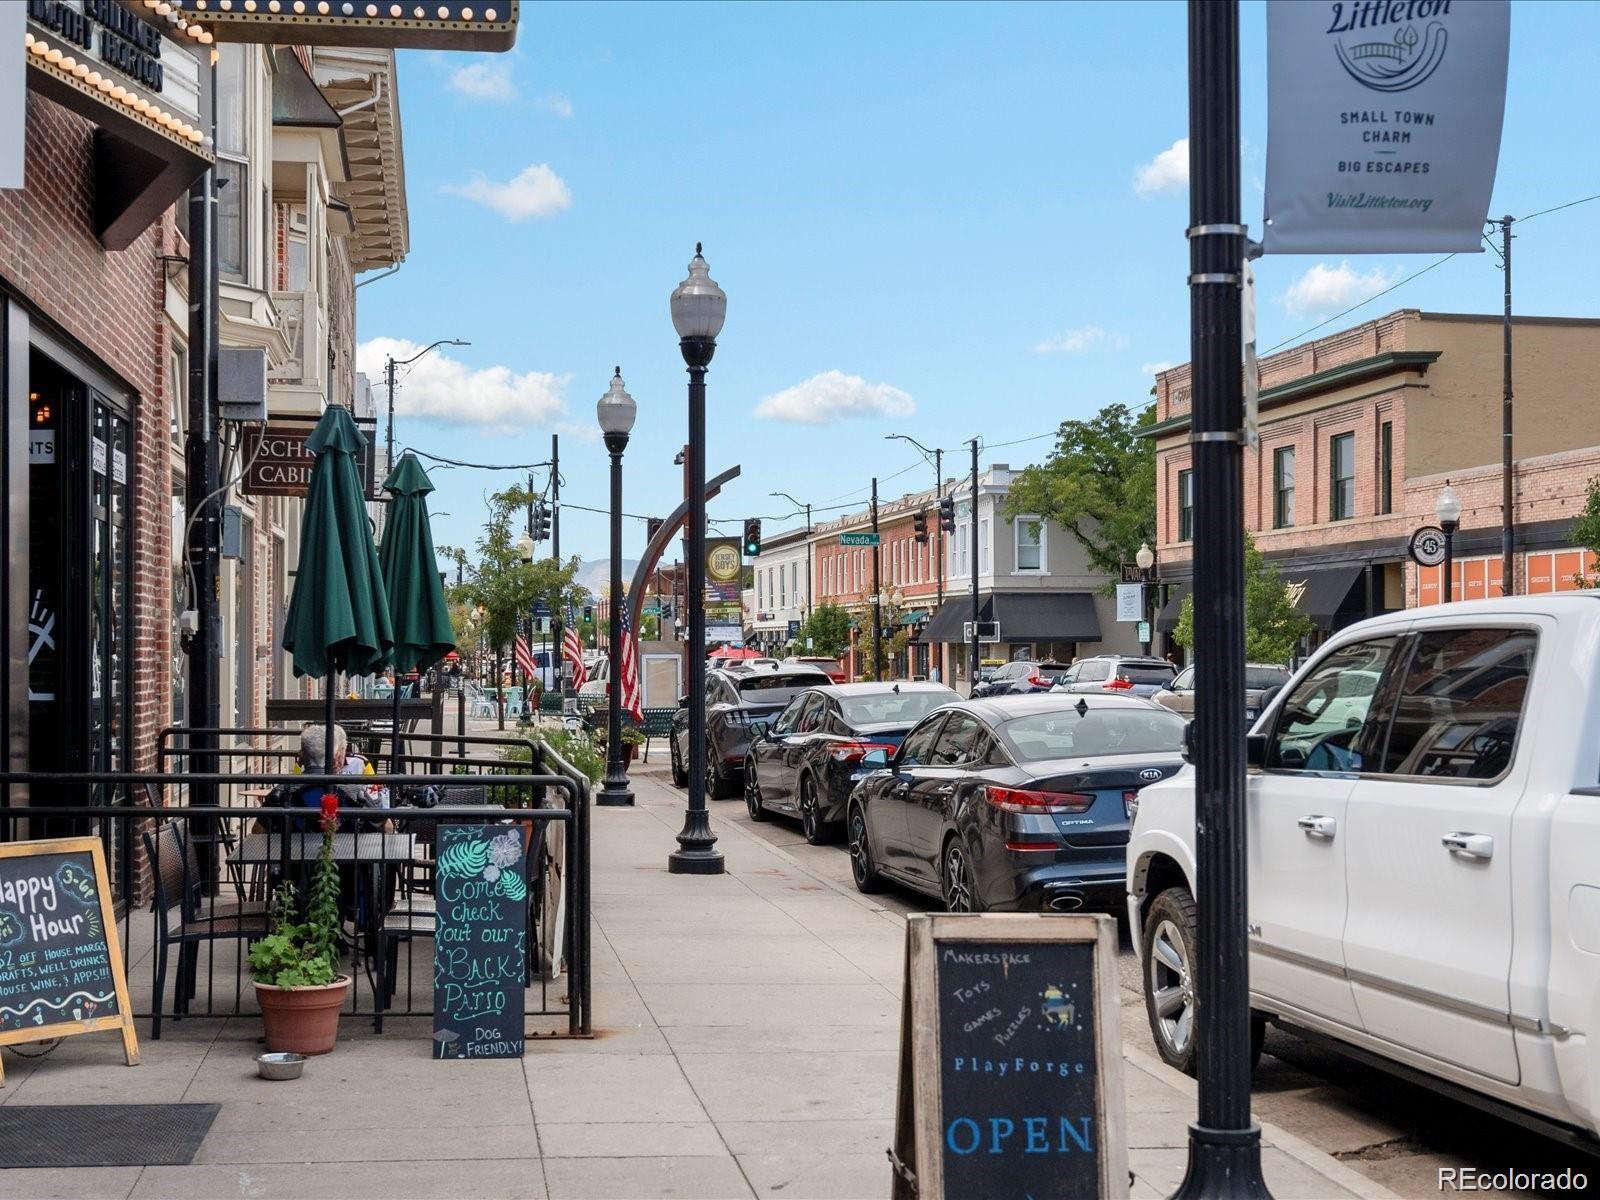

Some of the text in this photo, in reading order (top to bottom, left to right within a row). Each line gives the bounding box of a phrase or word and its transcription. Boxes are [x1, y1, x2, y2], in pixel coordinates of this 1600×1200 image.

[1326, 0, 1451, 34] Littleton
[1340, 110, 1435, 126] SMALL TOWN
[1362, 130, 1411, 143] CHARM
[1338, 161, 1430, 174] BIG ESCAPES
[1327, 192, 1433, 212] VisitLittleton.org
[840, 534, 870, 545] Nevada
[1423, 540, 1437, 553] 45
[715, 560, 735, 570] BOYS
[1143, 771, 1159, 780] KIA
[0, 875, 57, 914] appy
[441, 871, 506, 902] Come
[451, 900, 504, 923] check
[29, 912, 84, 943] Hour
[443, 924, 514, 943] out our
[20, 951, 37, 963] OFF
[44, 947, 73, 961] HOUSE
[446, 947, 517, 980] BACK
[943, 949, 1031, 965] MAKERSPACE
[38, 960, 68, 974] WELL
[443, 983, 506, 1012] PATIO
[953, 981, 991, 1004] TOYS
[963, 1006, 1003, 1033] GAMES
[994, 1005, 1032, 1047] PUZZLES
[475, 1027, 501, 1040] DOG
[467, 1040, 523, 1057] FRIENDLY!
[954, 1057, 1084, 1077] PlayForge
[946, 1116, 1093, 1155] OPEN
